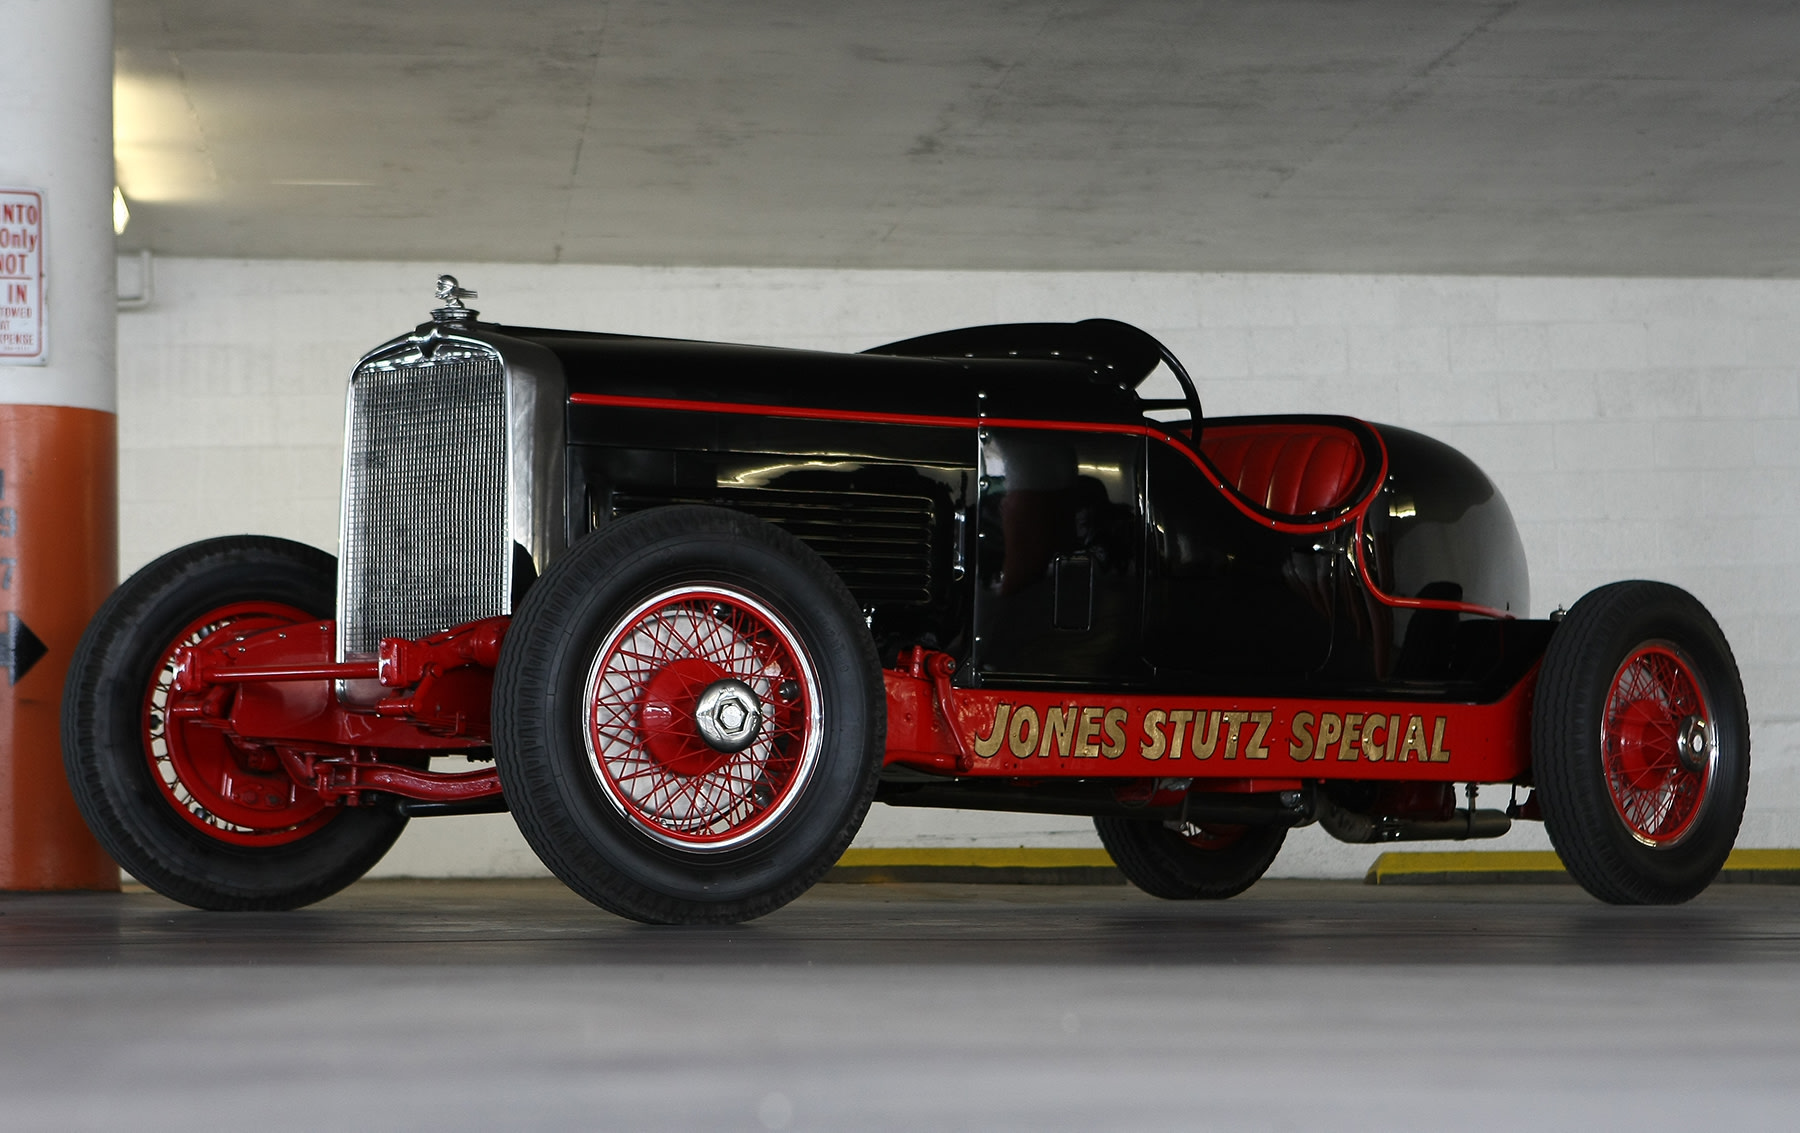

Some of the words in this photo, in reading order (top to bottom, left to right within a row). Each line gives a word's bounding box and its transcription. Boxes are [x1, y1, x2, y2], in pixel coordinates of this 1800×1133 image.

[0, 228, 37, 253] Only
[8, 284, 27, 304] IN
[974, 703, 1128, 759] JONES
[1140, 708, 1273, 761] STUTZ
[1288, 710, 1451, 763] SPECIAL
